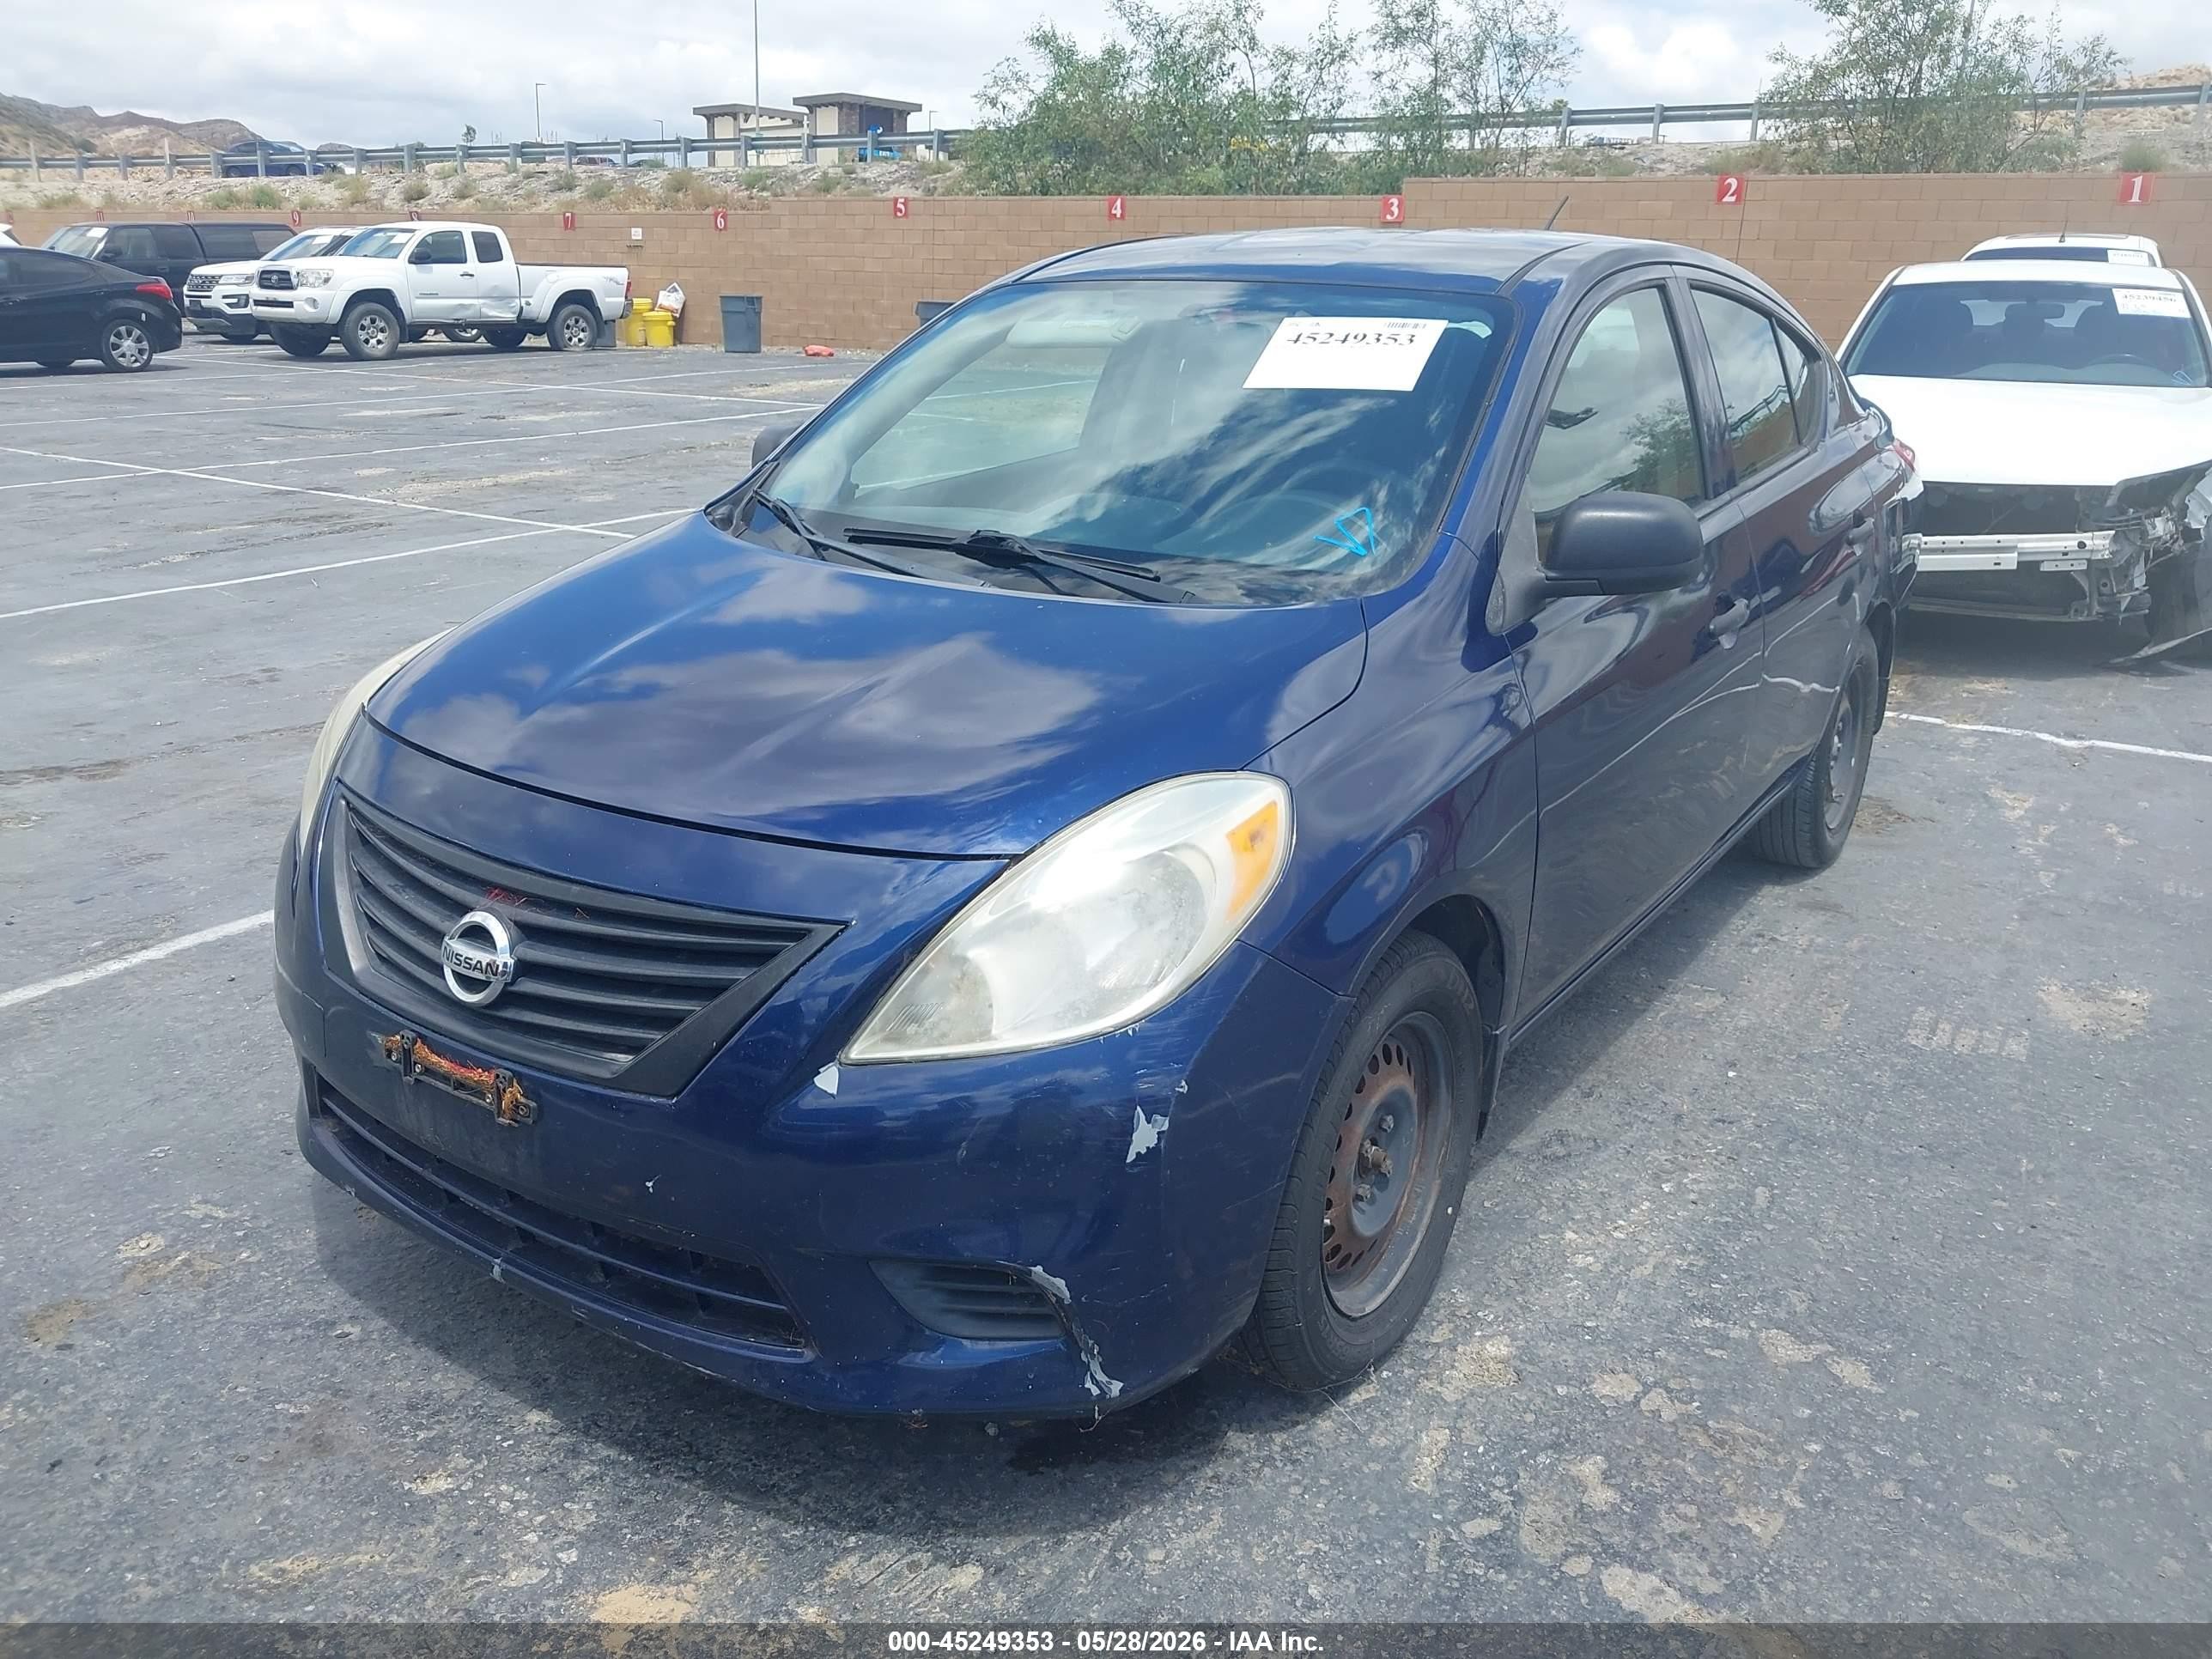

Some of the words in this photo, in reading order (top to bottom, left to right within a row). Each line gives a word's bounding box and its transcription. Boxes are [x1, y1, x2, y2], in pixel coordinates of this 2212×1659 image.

[1722, 178, 1738, 202] 2
[2127, 175, 2143, 203] 1
[896, 198, 905, 216] 5
[1111, 198, 1121, 217] 4
[1386, 198, 1399, 220] 3
[293, 211, 300, 226] 9
[565, 212, 572, 228] 7
[717, 212, 725, 229] 6
[1286, 331, 1416, 345] 45249353
[442, 945, 500, 977] NISSAN
